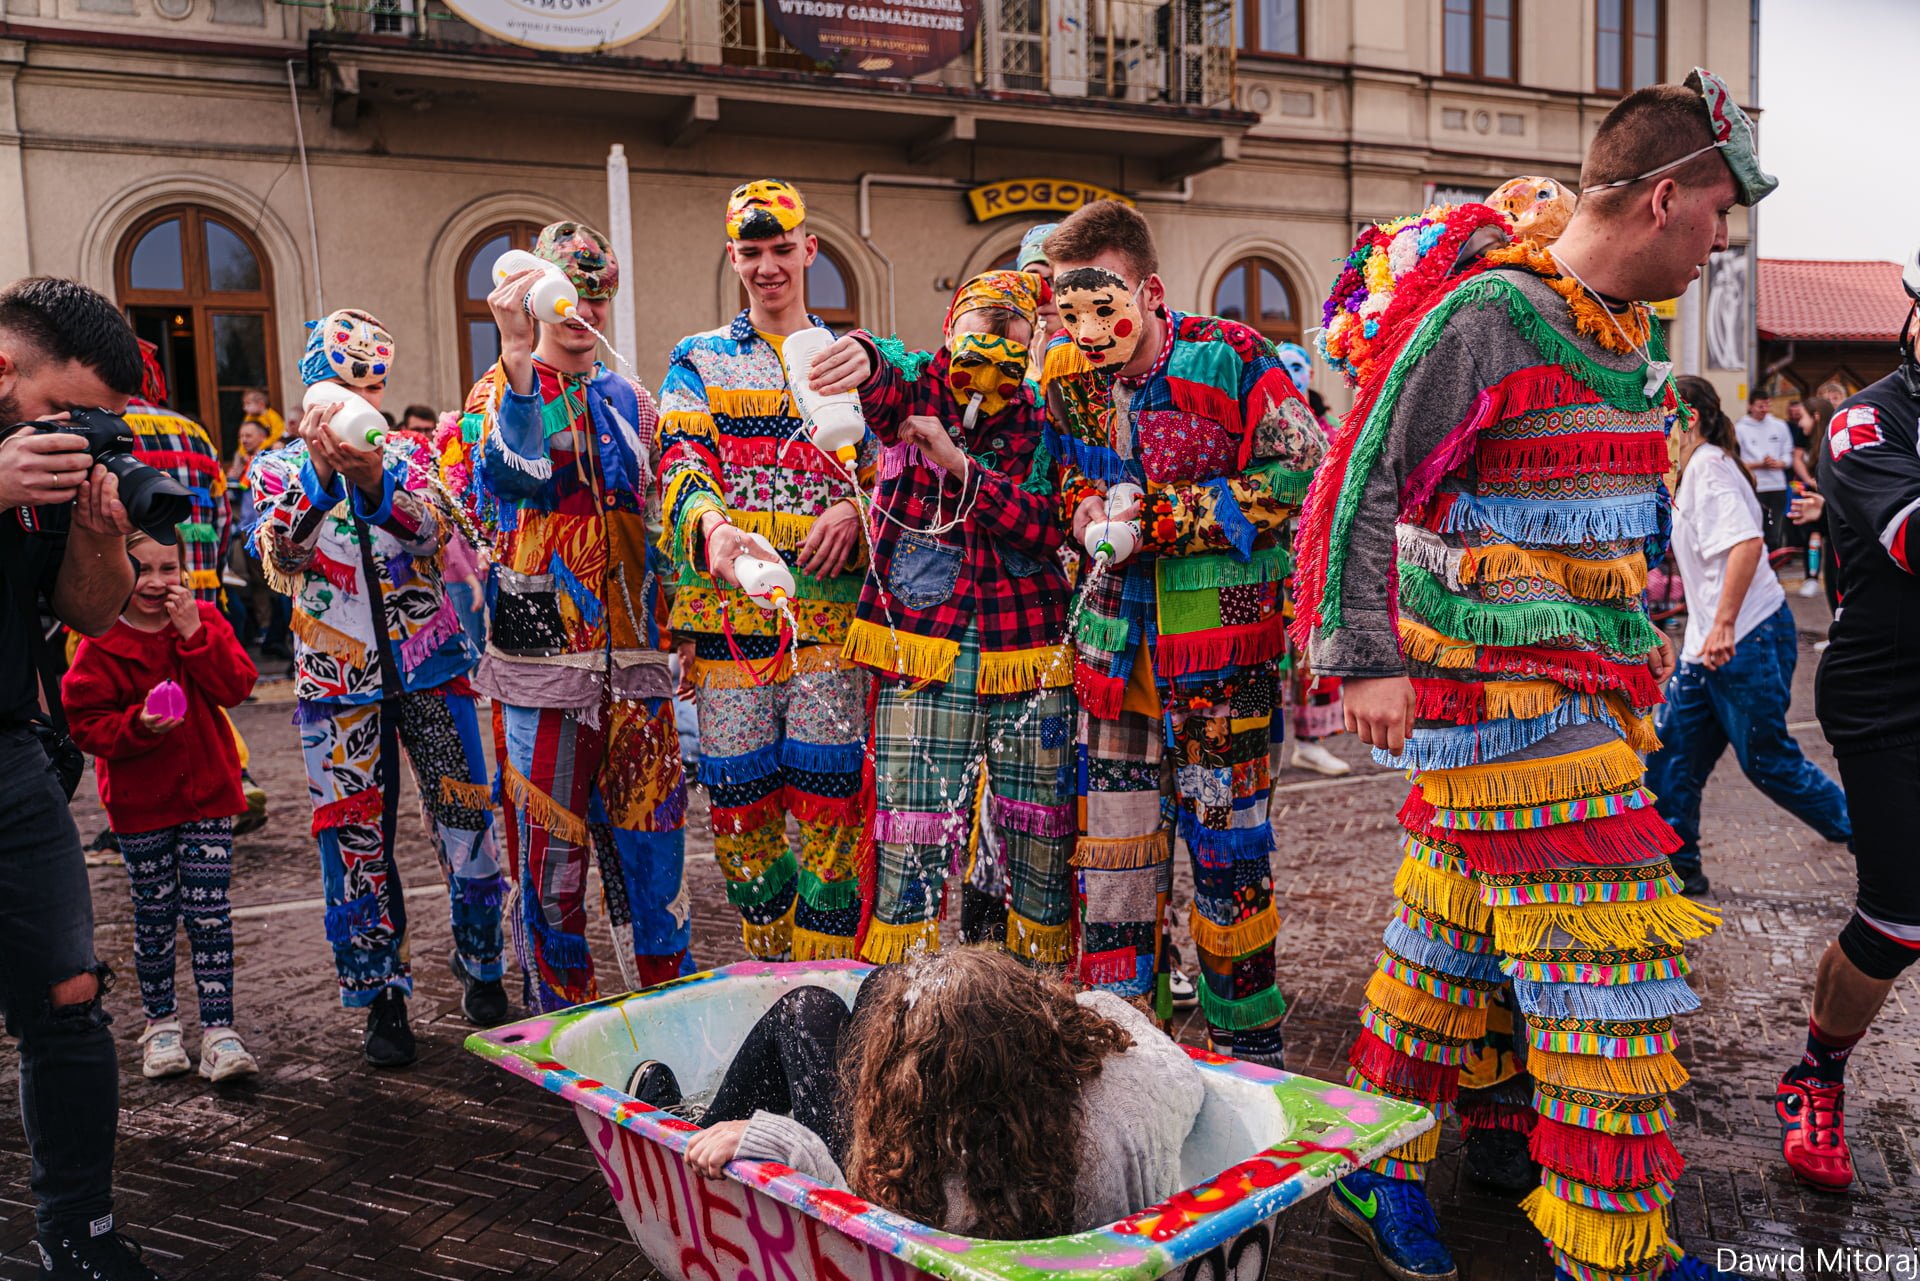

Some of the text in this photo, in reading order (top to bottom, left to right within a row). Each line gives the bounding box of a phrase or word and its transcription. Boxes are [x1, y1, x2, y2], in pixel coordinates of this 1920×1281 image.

[778, 0, 964, 31] WYROBY GARMAŻERYJNE
[982, 183, 1123, 212] ROGOW
